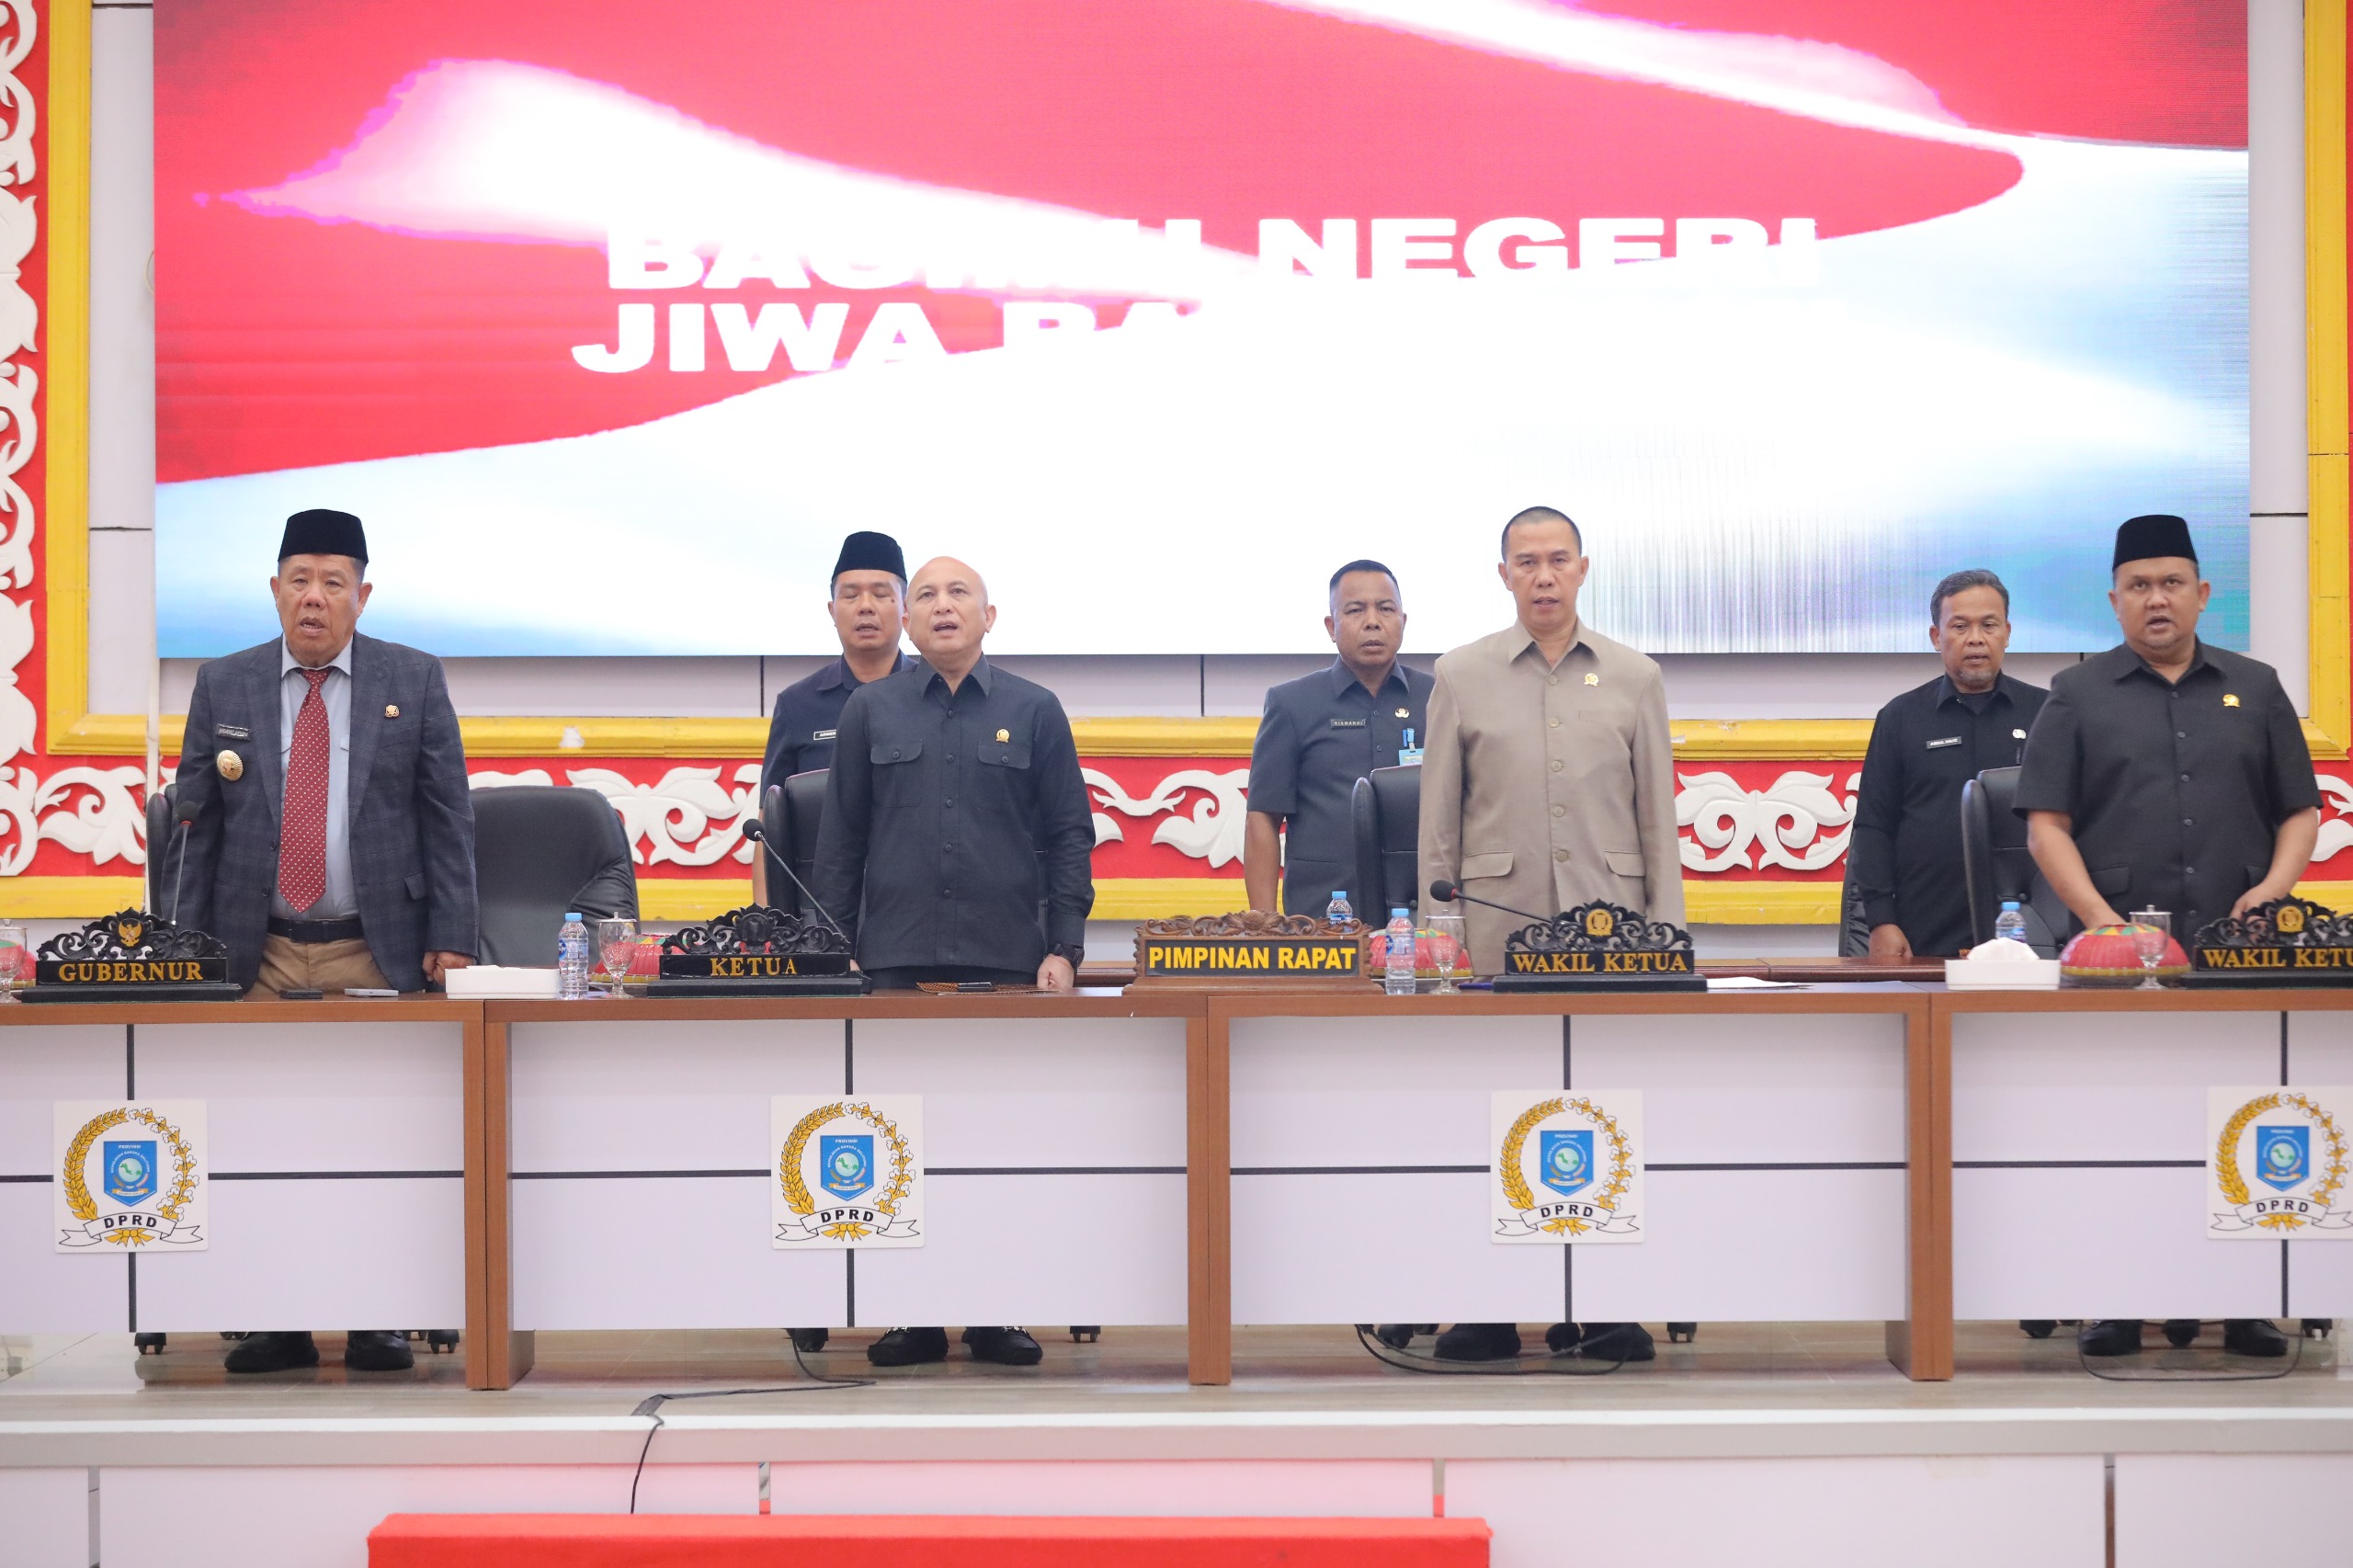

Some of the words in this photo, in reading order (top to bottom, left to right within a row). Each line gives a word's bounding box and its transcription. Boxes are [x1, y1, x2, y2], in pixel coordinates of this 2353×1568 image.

[571, 302, 949, 372] JIWA
[710, 957, 798, 976] KETUA
[1149, 947, 1269, 969] PIMPINAN
[1278, 948, 1356, 970] RAPAT
[1512, 953, 1595, 972] WAKIL
[1603, 952, 1688, 972] KETUA
[2202, 948, 2287, 968] WAKIL
[58, 961, 203, 982] GUBERNUR
[1540, 1204, 1594, 1218] DPRD
[2256, 1199, 2309, 1213] DPRD
[104, 1215, 157, 1229] DPRD
[821, 1209, 874, 1223] DPRD
